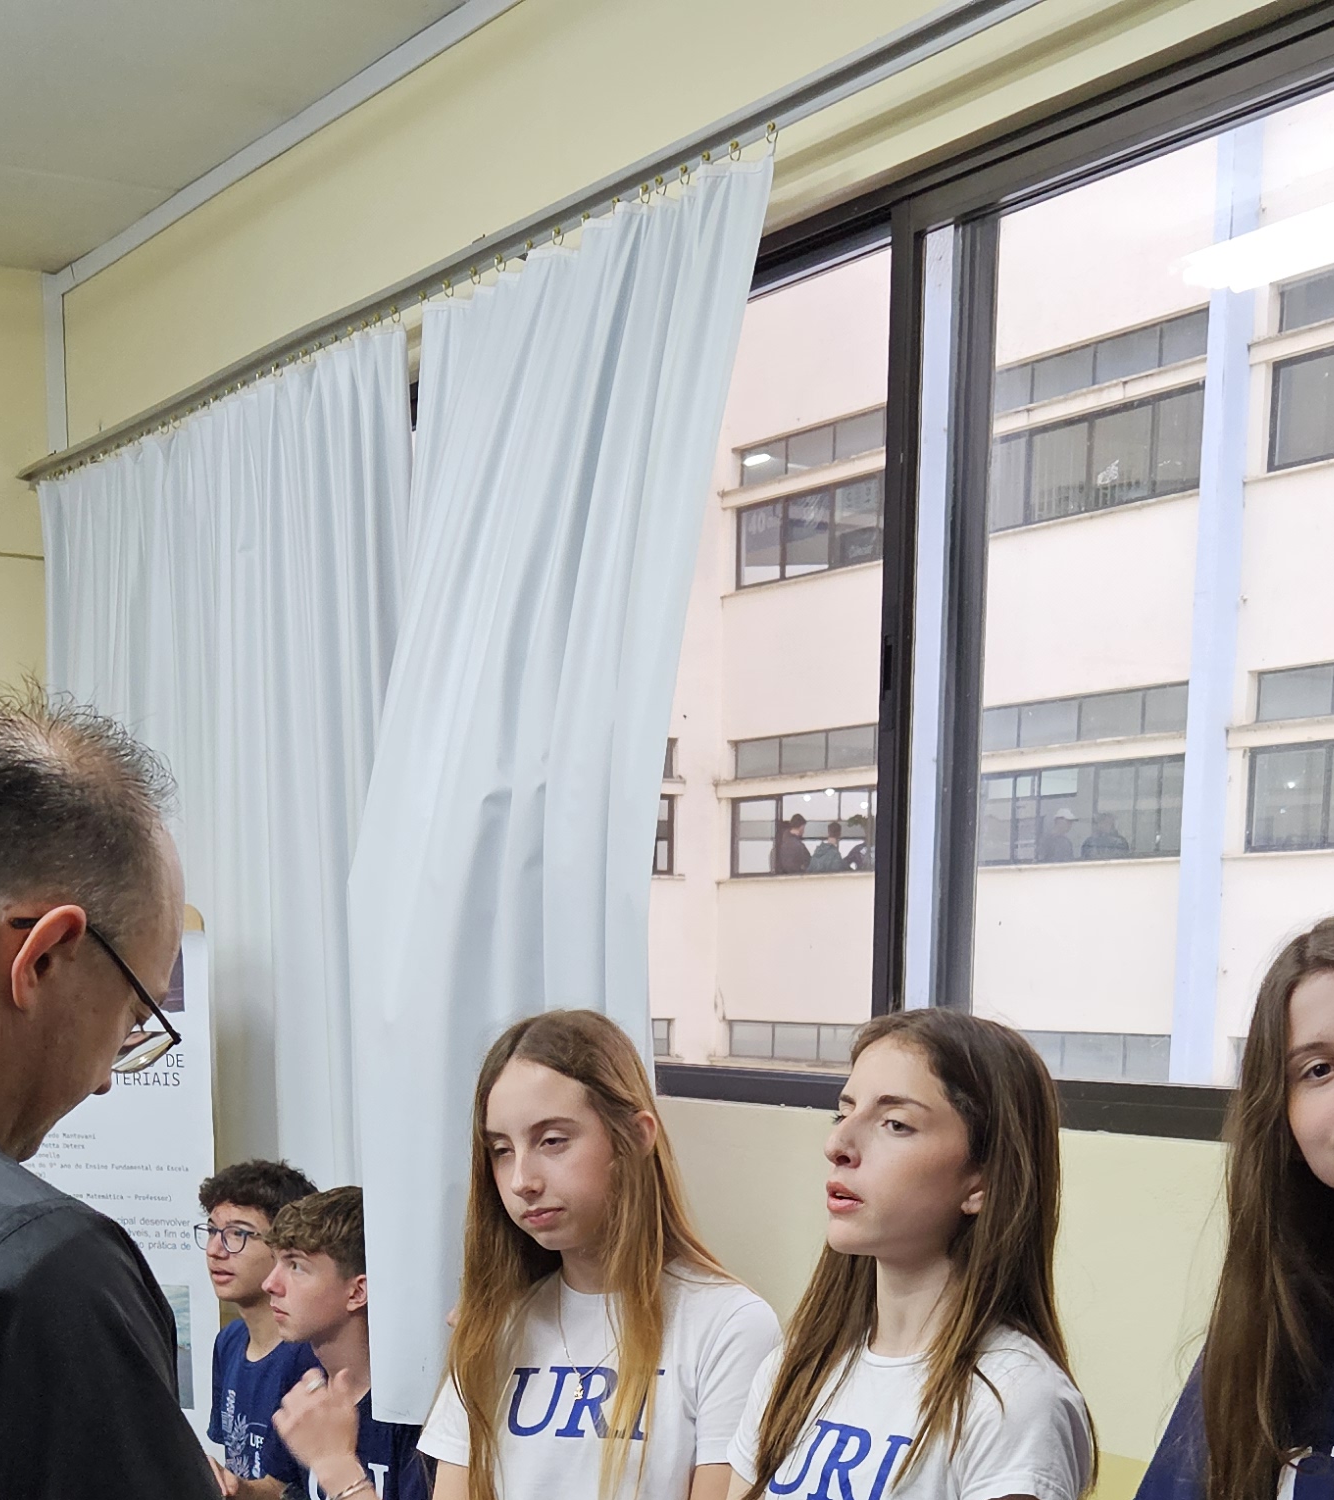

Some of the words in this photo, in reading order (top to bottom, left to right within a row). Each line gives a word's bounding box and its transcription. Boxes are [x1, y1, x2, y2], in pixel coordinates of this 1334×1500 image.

[166, 1053, 185, 1069] DE
[116, 1071, 181, 1087] TERIAIS
[111, 1162, 152, 1172] Fundamental
[139, 1216, 191, 1227] desenvolver
[154, 1231, 161, 1239] a
[164, 1229, 177, 1239] fim
[180, 1230, 191, 1239] de
[148, 1240, 178, 1251] prática
[180, 1241, 192, 1251] de
[508, 1366, 665, 1441] URI
